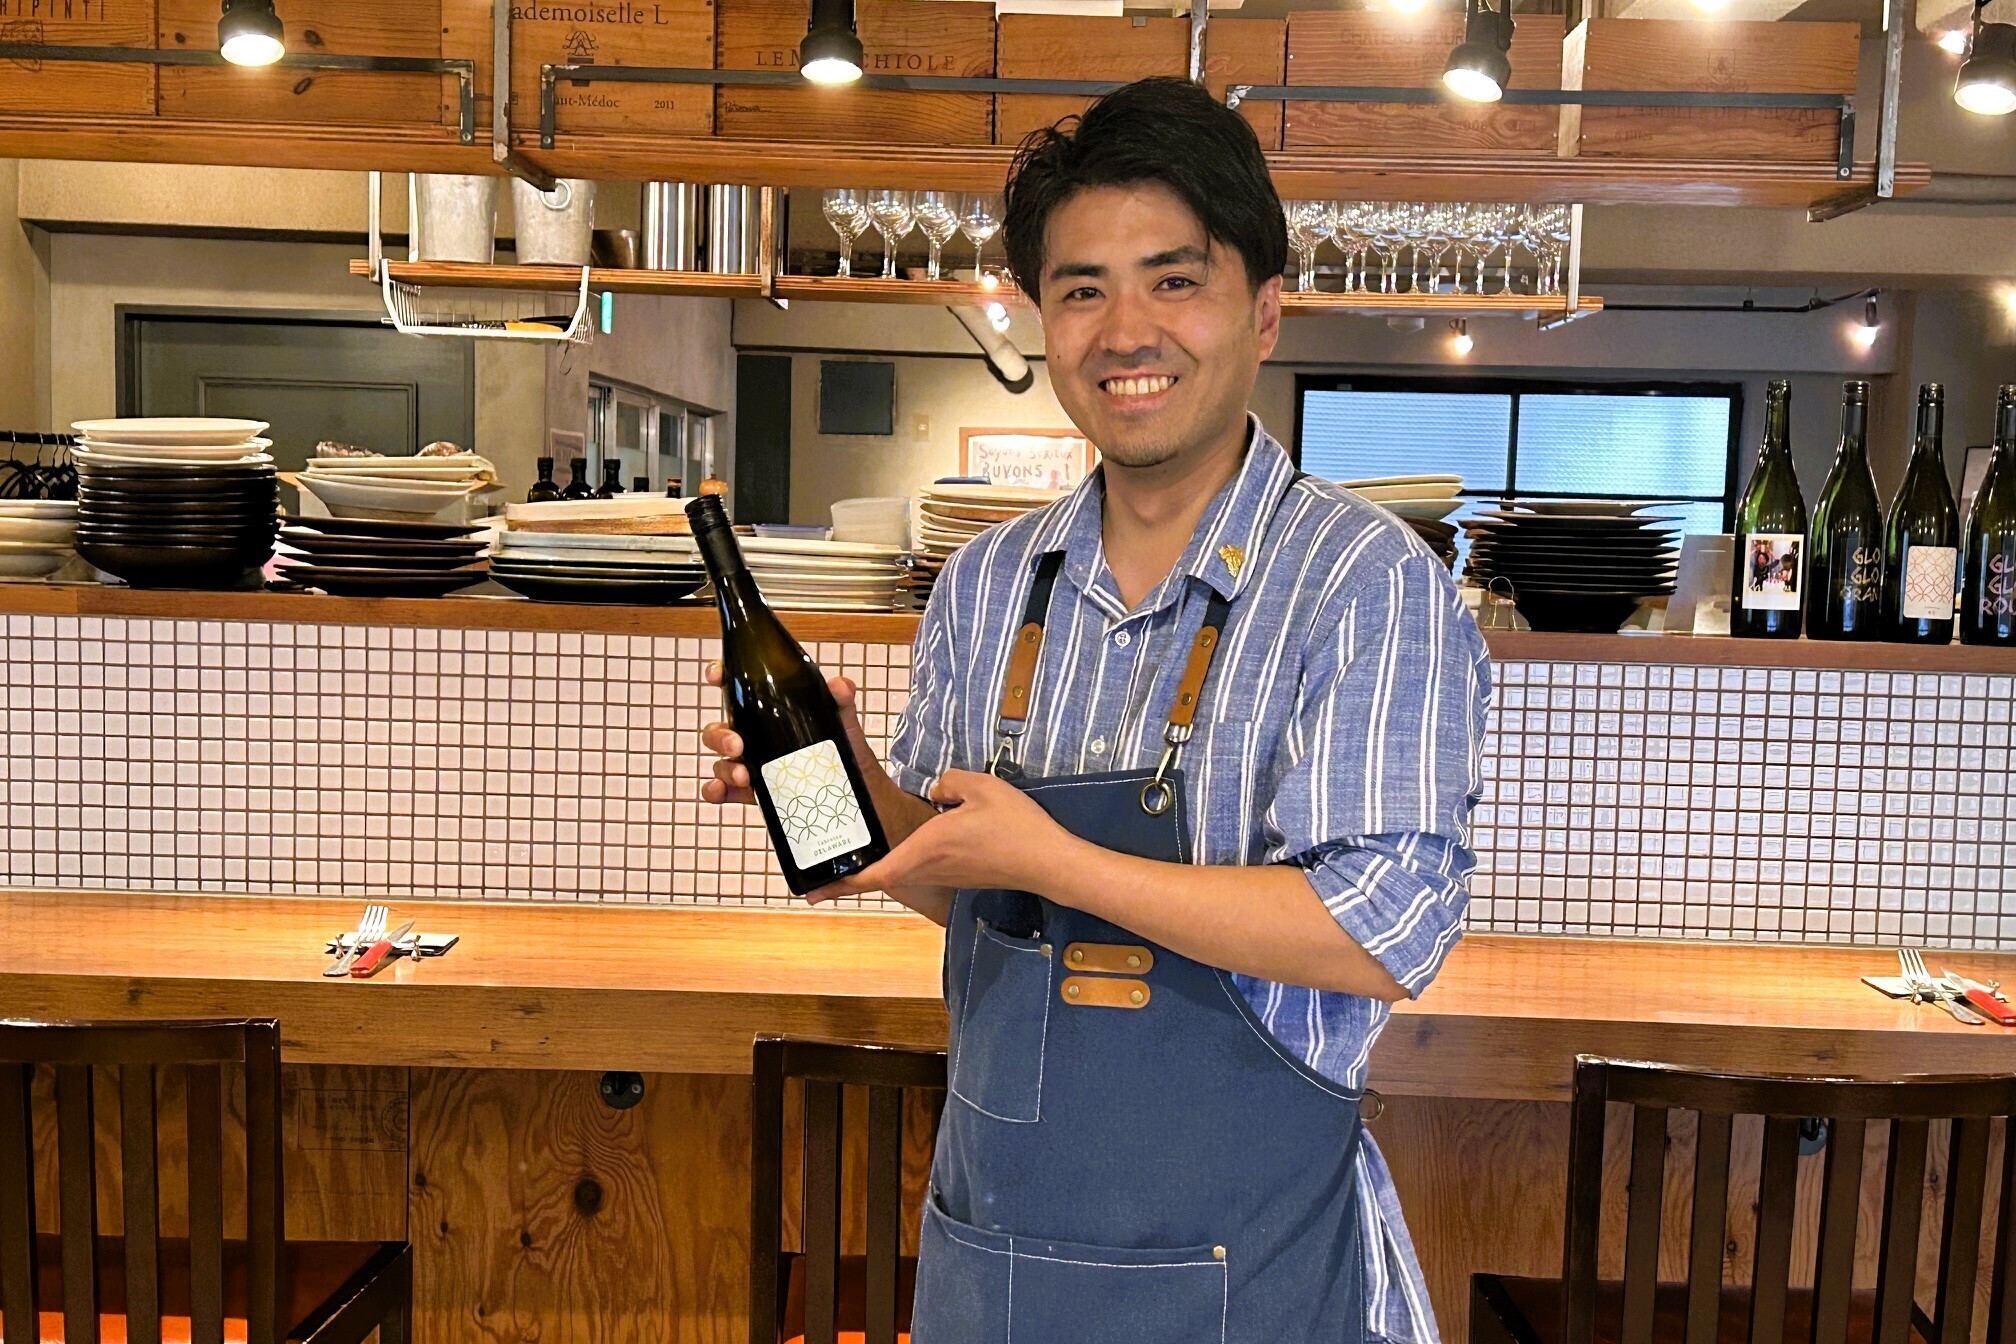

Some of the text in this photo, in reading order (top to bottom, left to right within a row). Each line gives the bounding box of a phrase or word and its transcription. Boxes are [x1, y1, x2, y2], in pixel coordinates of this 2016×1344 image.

[511, 0, 669, 25] ademoiselle L
[555, 94, 674, 110] aut-Médoc 2011
